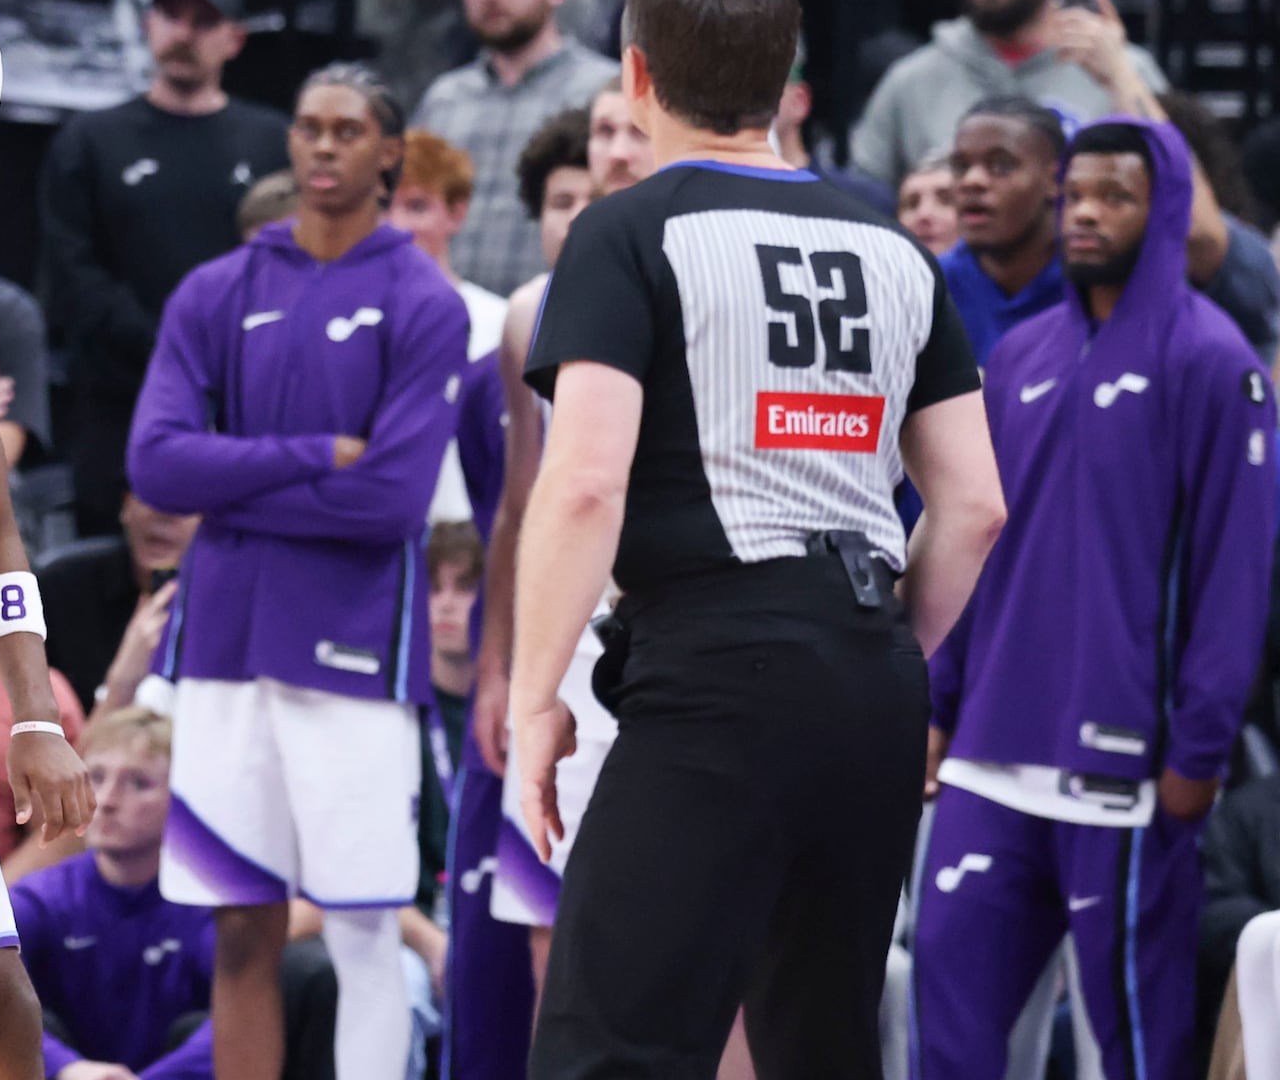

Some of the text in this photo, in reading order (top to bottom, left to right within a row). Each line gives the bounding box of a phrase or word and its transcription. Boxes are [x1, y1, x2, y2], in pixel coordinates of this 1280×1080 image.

[755, 244, 872, 374] 52
[768, 405, 870, 438] Emirates
[1, 584, 27, 621] 8
